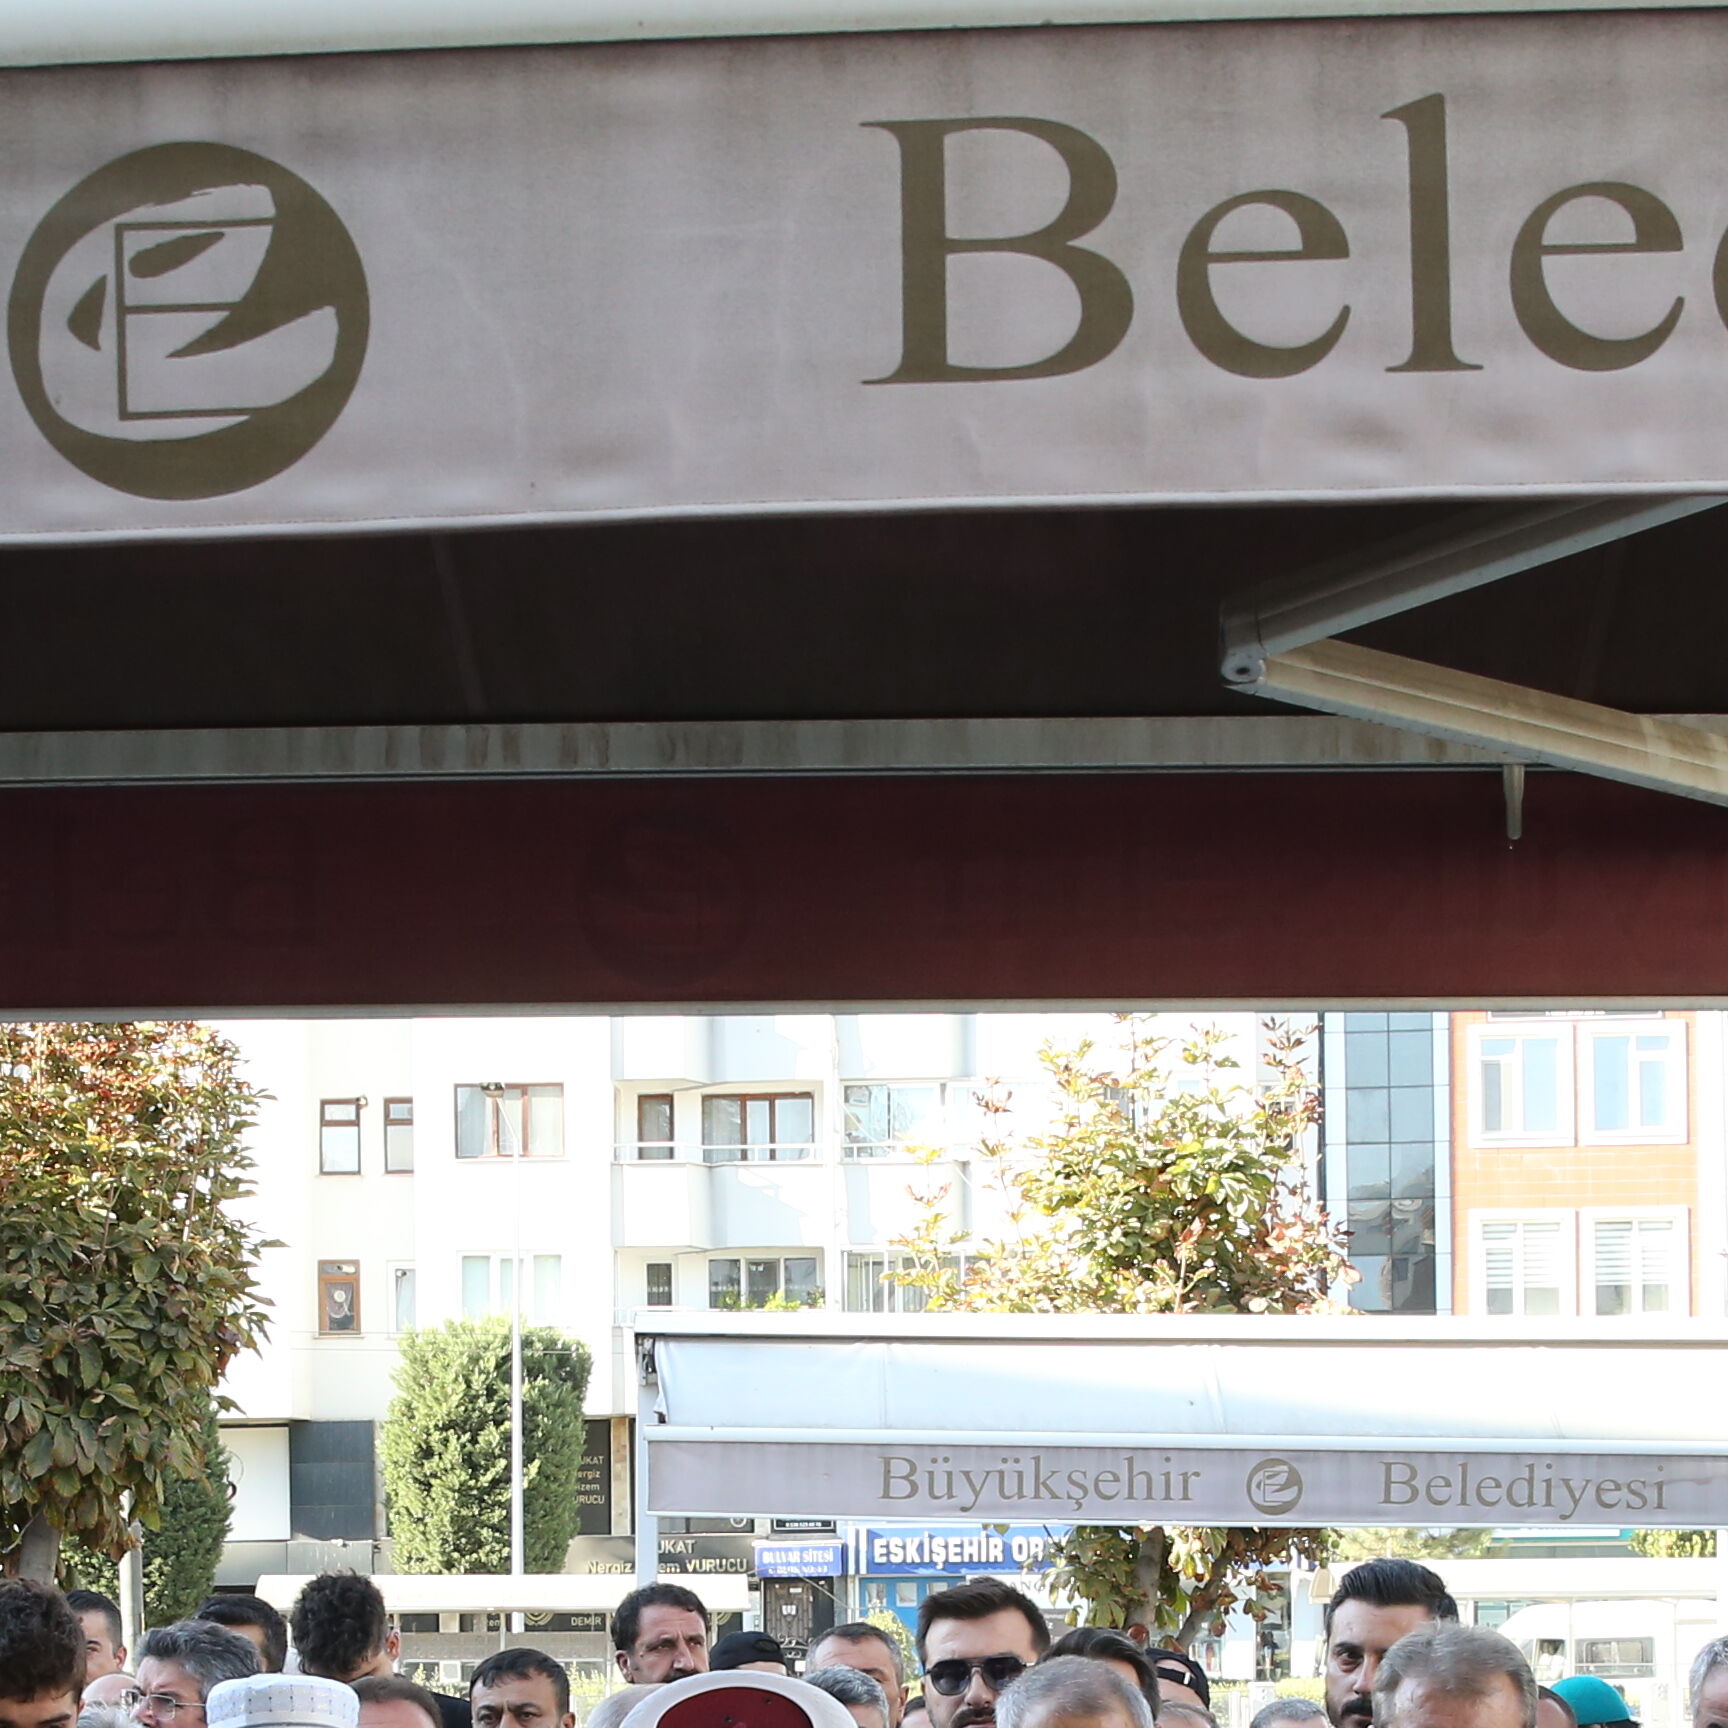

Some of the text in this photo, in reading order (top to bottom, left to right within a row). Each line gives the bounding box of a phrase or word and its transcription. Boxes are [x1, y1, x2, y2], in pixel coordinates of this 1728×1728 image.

[877, 1456, 1667, 1520] Büyükşehir Belediyesi
[685, 1558, 747, 1573] VURUCU
[874, 1530, 1003, 1569] ESKİŞEHİR
